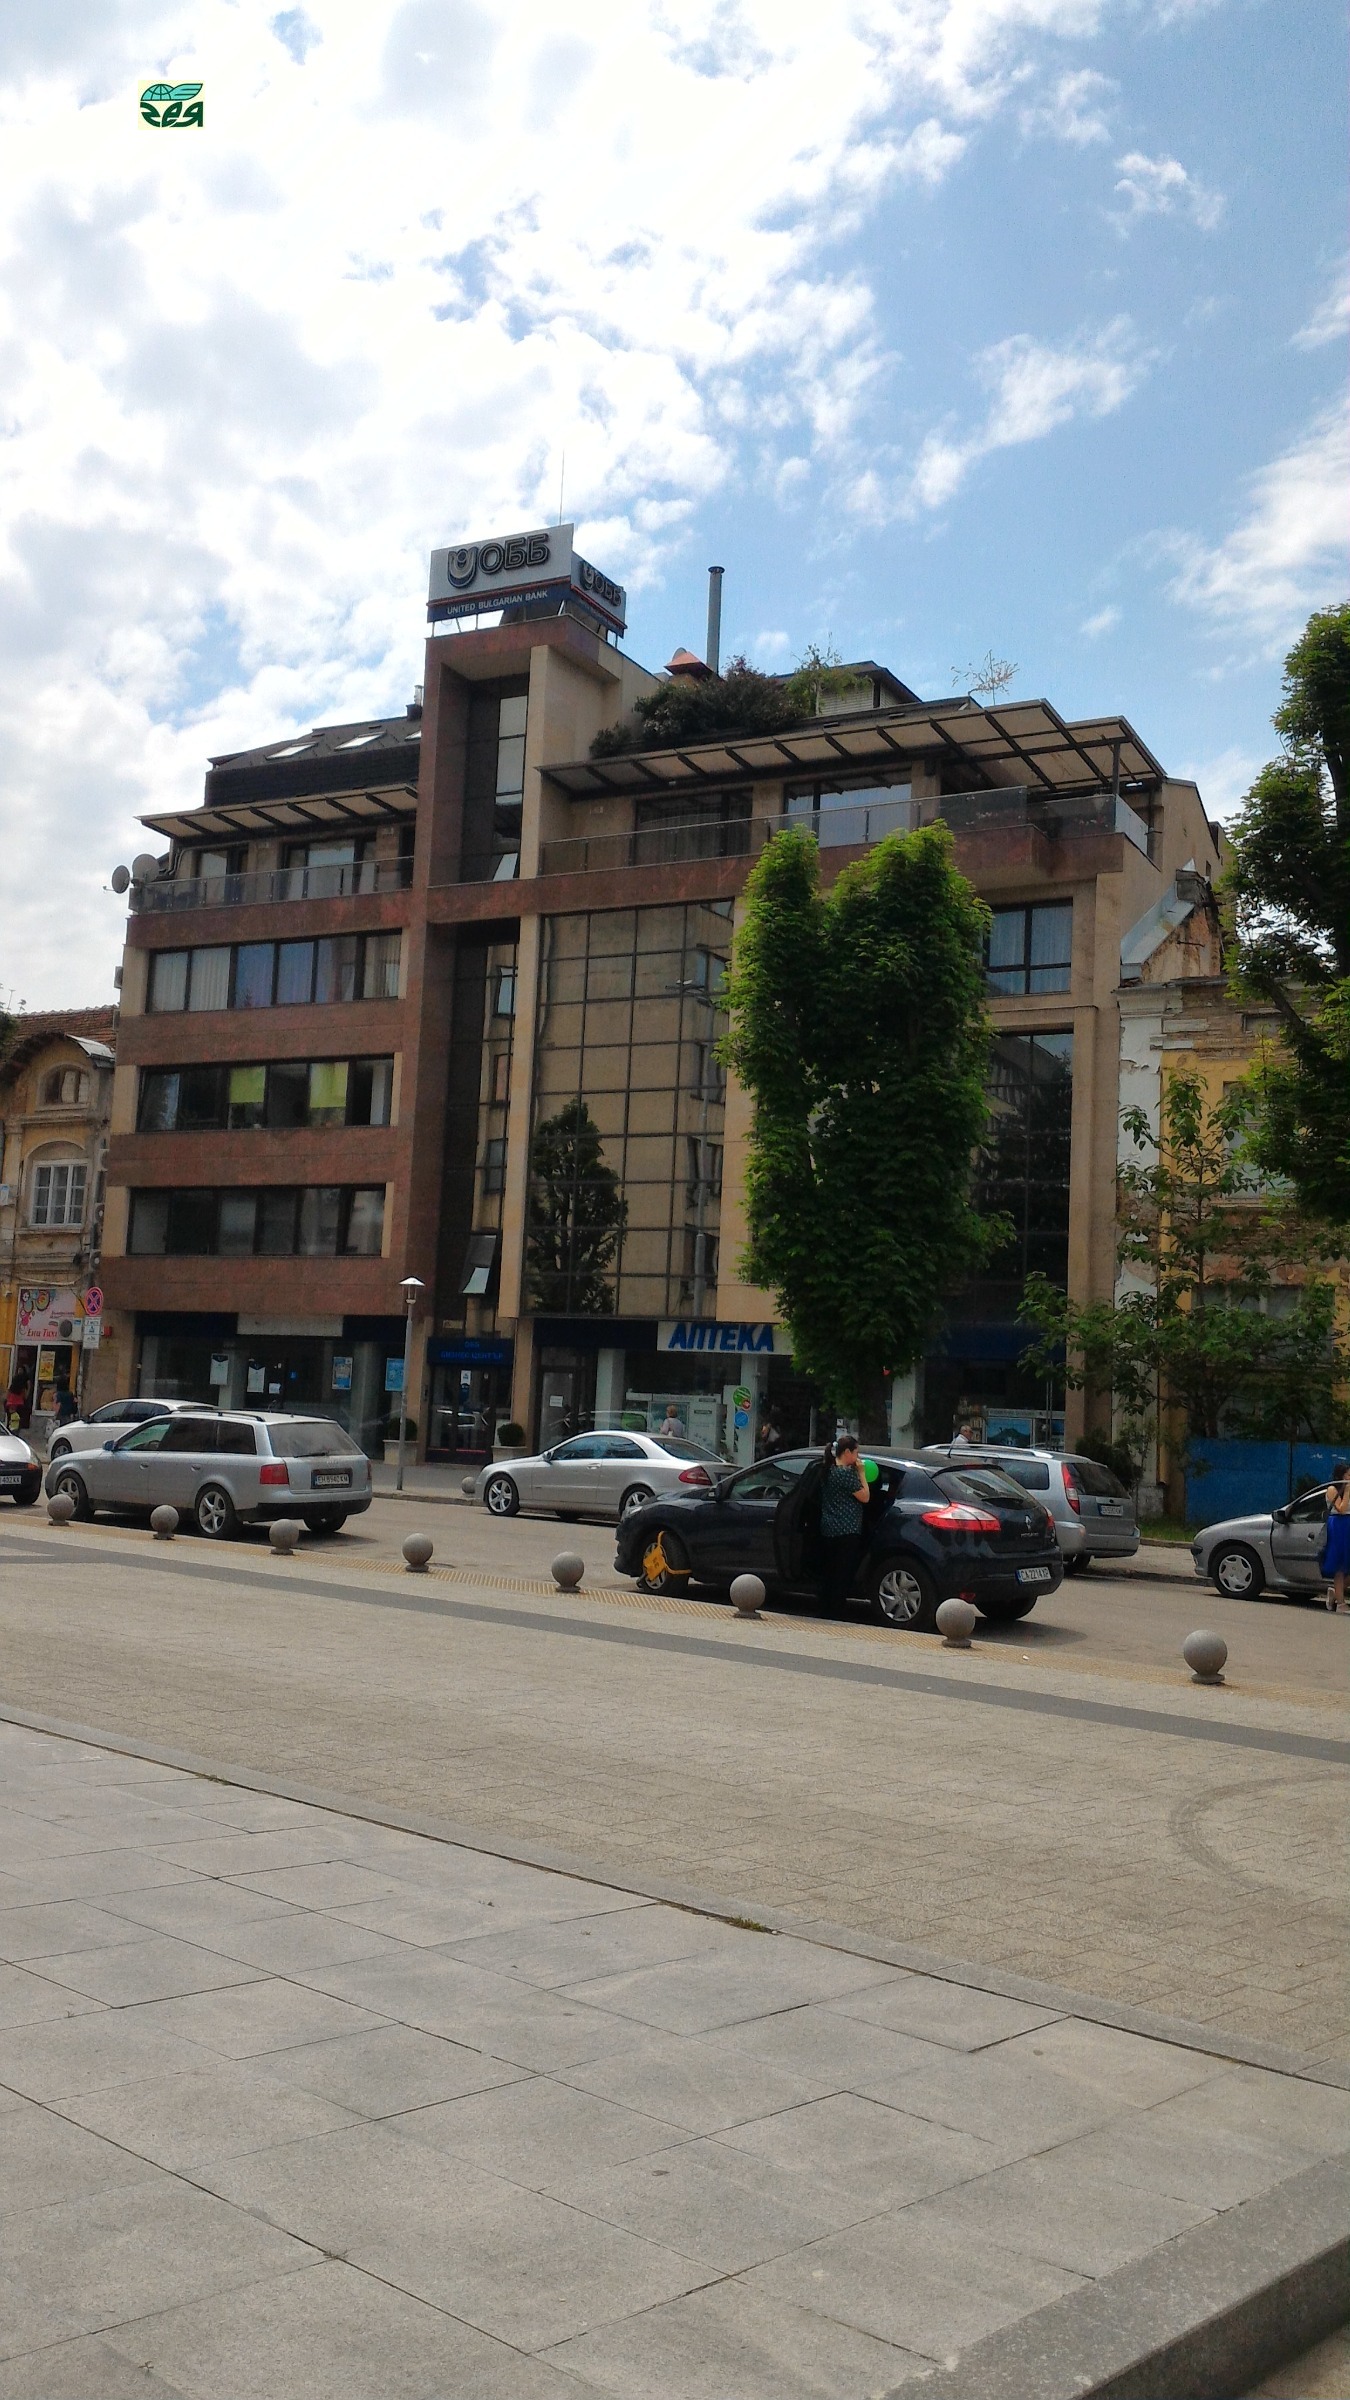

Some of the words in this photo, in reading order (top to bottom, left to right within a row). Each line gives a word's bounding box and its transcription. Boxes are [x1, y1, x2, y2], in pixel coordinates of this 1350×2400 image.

[447, 603, 476, 615] UNITED
[478, 595, 523, 611] BULGARIAN
[525, 590, 548, 601] BANK
[668, 1321, 775, 1352] АПТЕКА
